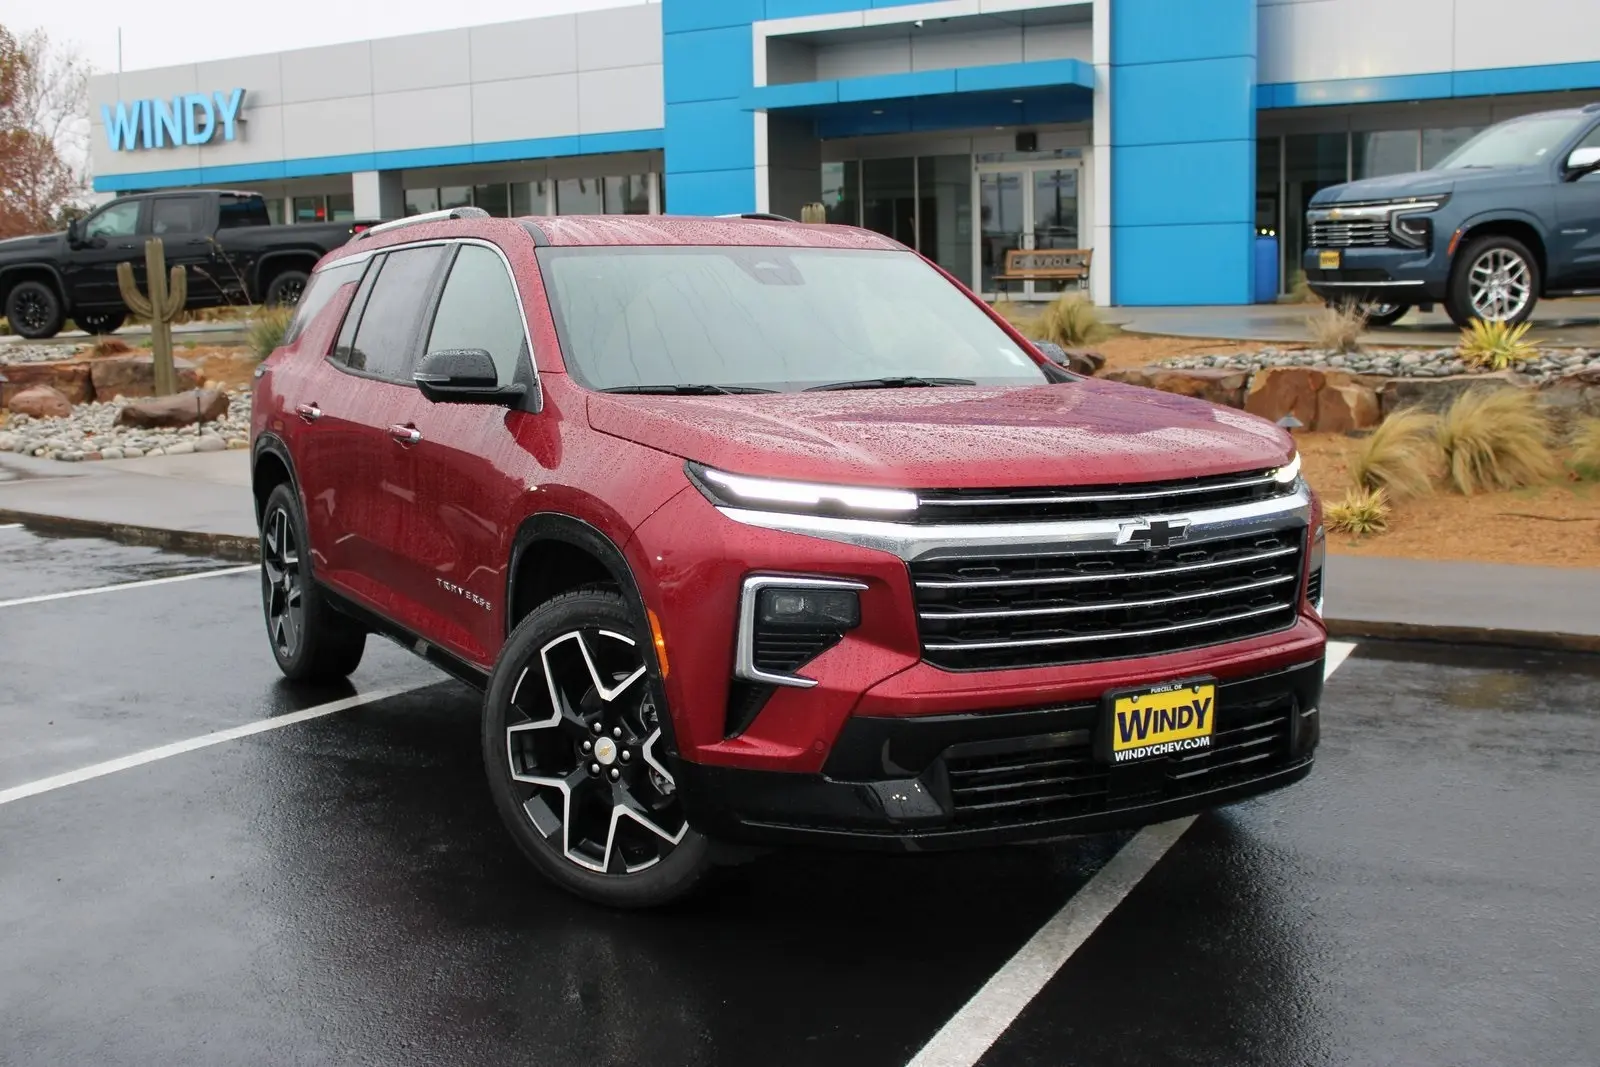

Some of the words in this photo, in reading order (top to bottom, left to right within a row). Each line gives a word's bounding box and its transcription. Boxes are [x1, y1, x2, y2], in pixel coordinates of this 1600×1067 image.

[101, 88, 243, 151] WINDY
[436, 577, 492, 611] TRAVERSE
[1117, 698, 1212, 743] WINDY
[1115, 736, 1210, 762] WINDYCHEV.COM
